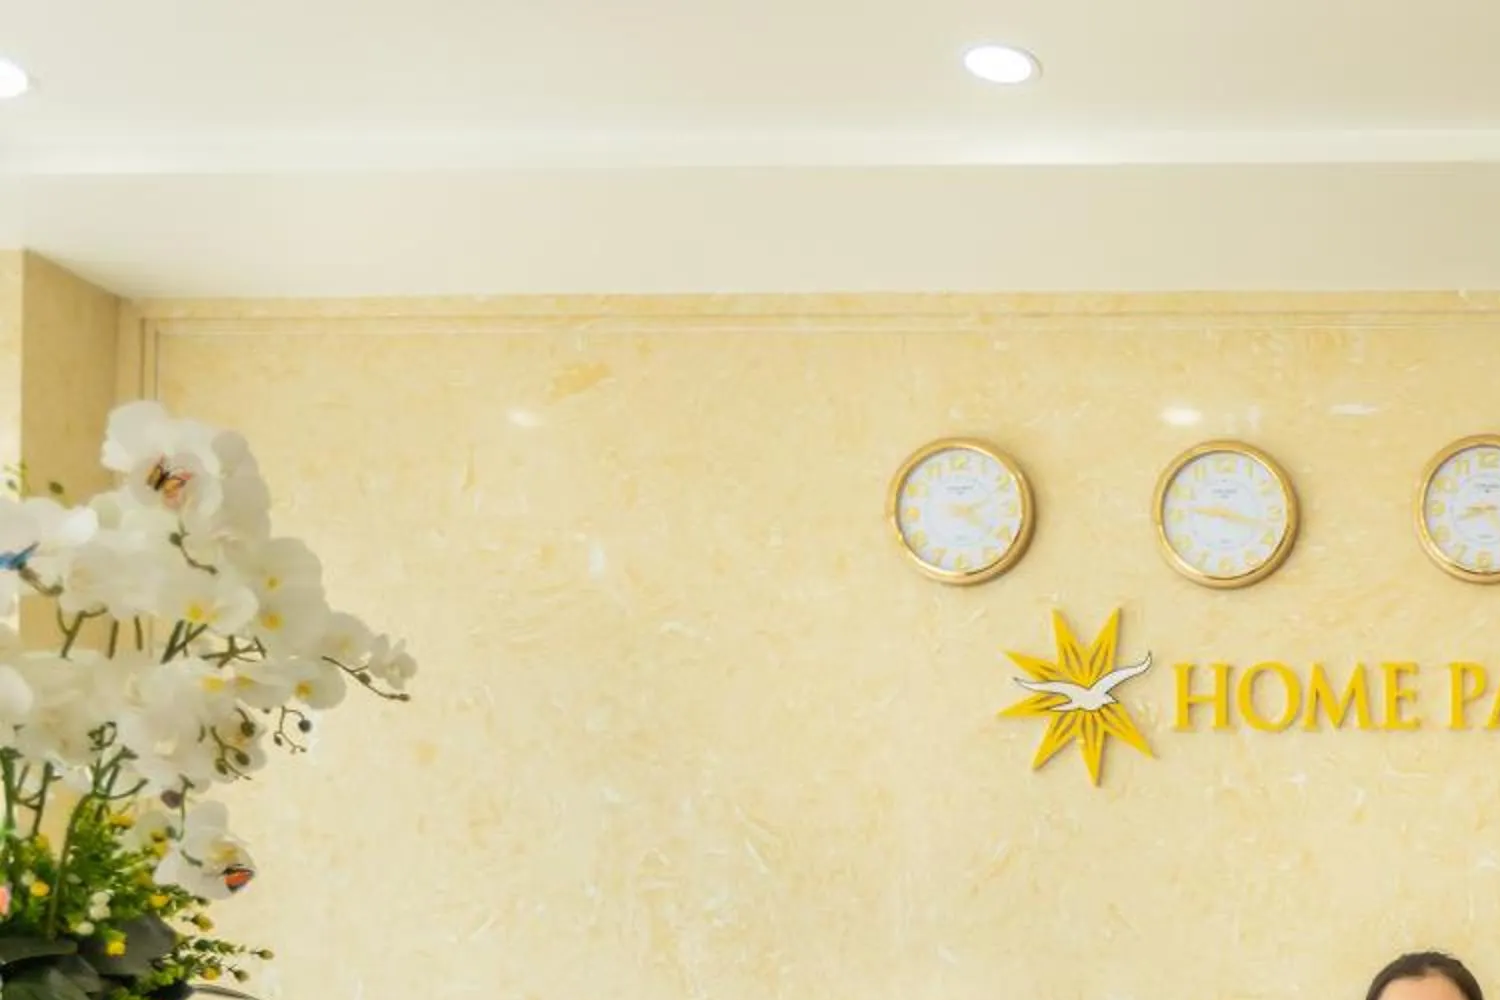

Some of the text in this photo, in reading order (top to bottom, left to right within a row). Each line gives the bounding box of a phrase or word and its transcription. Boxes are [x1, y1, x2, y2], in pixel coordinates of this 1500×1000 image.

[1454, 456, 1470, 476] 11
[1475, 449, 1500, 469] 12
[1173, 660, 1421, 732] HOME
